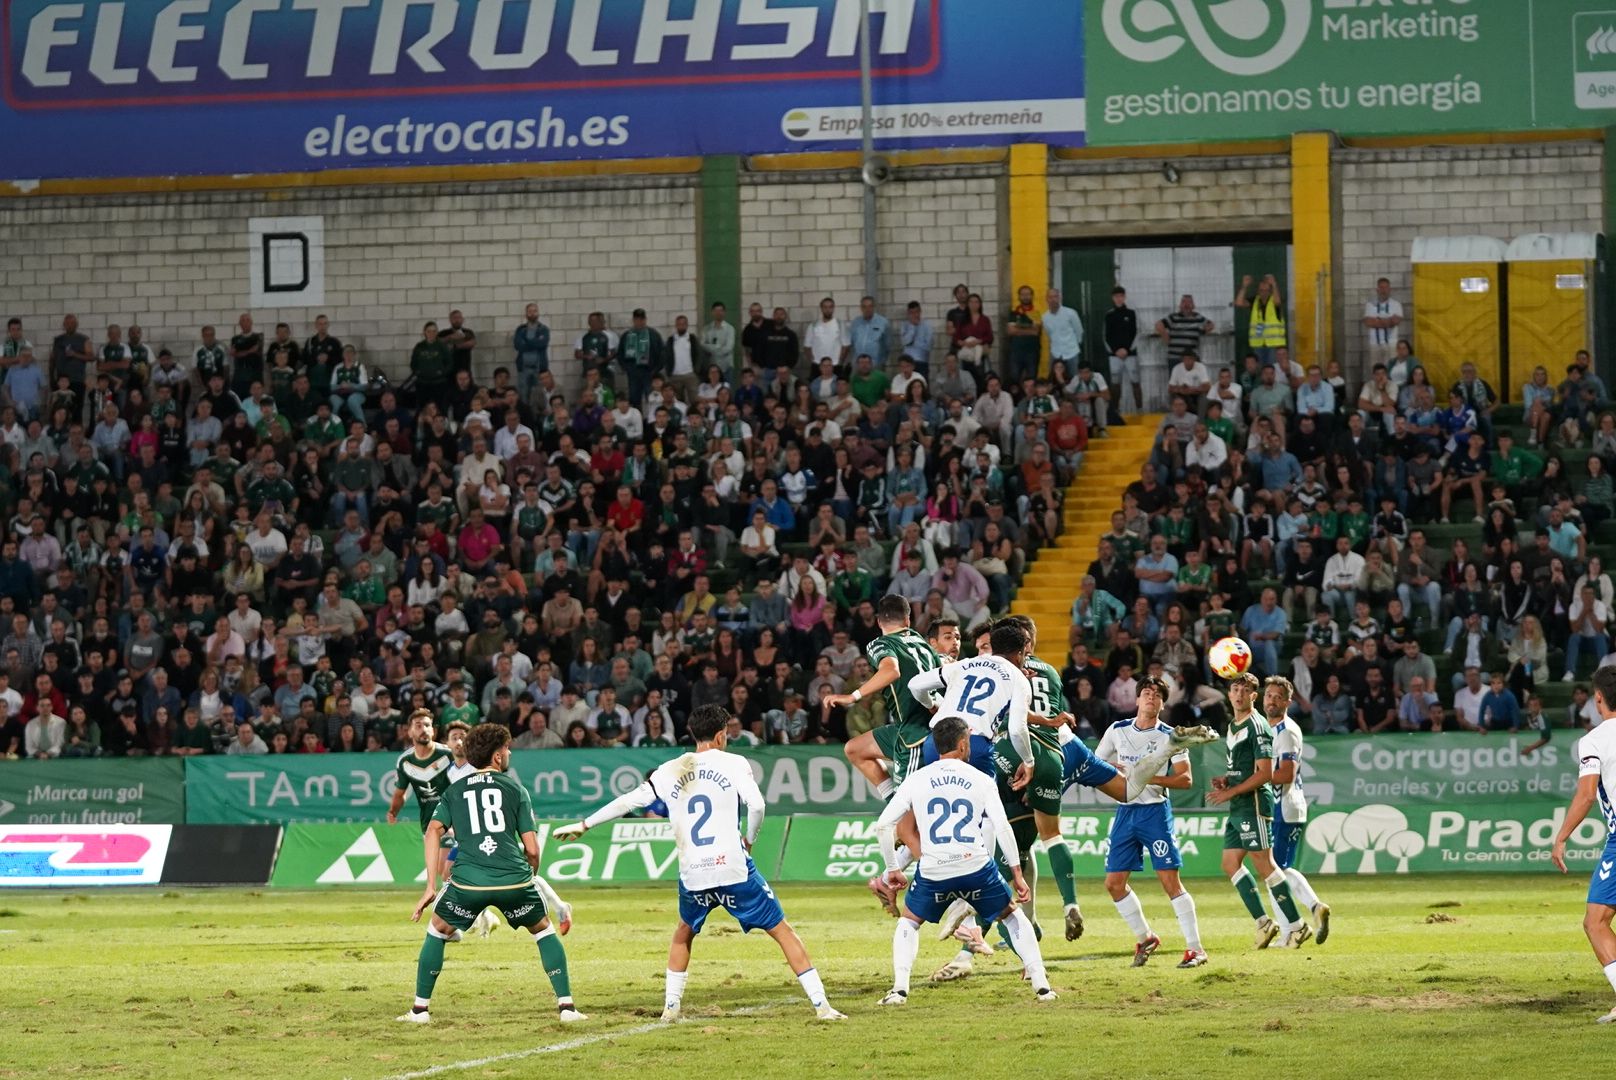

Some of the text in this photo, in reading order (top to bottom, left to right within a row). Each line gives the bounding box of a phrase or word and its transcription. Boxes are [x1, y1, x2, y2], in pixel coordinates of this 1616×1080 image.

[1322, 10, 1479, 41] Marketing
[1104, 74, 1481, 123] gestionamos tu energía
[305, 107, 629, 157] electrocash.es
[901, 112, 943, 128] 100%
[947, 108, 1043, 127] extremeña
[262, 232, 310, 293] D
[956, 674, 996, 717] 12
[1352, 738, 1558, 776] Corrugados
[93, 788, 113, 800] un
[116, 782, 144, 803] gol
[671, 769, 732, 800] DAVID RGUEZ
[930, 775, 972, 790] ÁLVARO
[1352, 776, 1429, 797] Paneles
[1435, 781, 1448, 798] y
[1453, 778, 1520, 795] aceros
[1526, 773, 1551, 792] de
[463, 788, 506, 835] 18
[687, 794, 715, 847] 2
[927, 797, 975, 844] 22
[1441, 849, 1457, 861] Tu
[1463, 849, 1523, 862] centro
